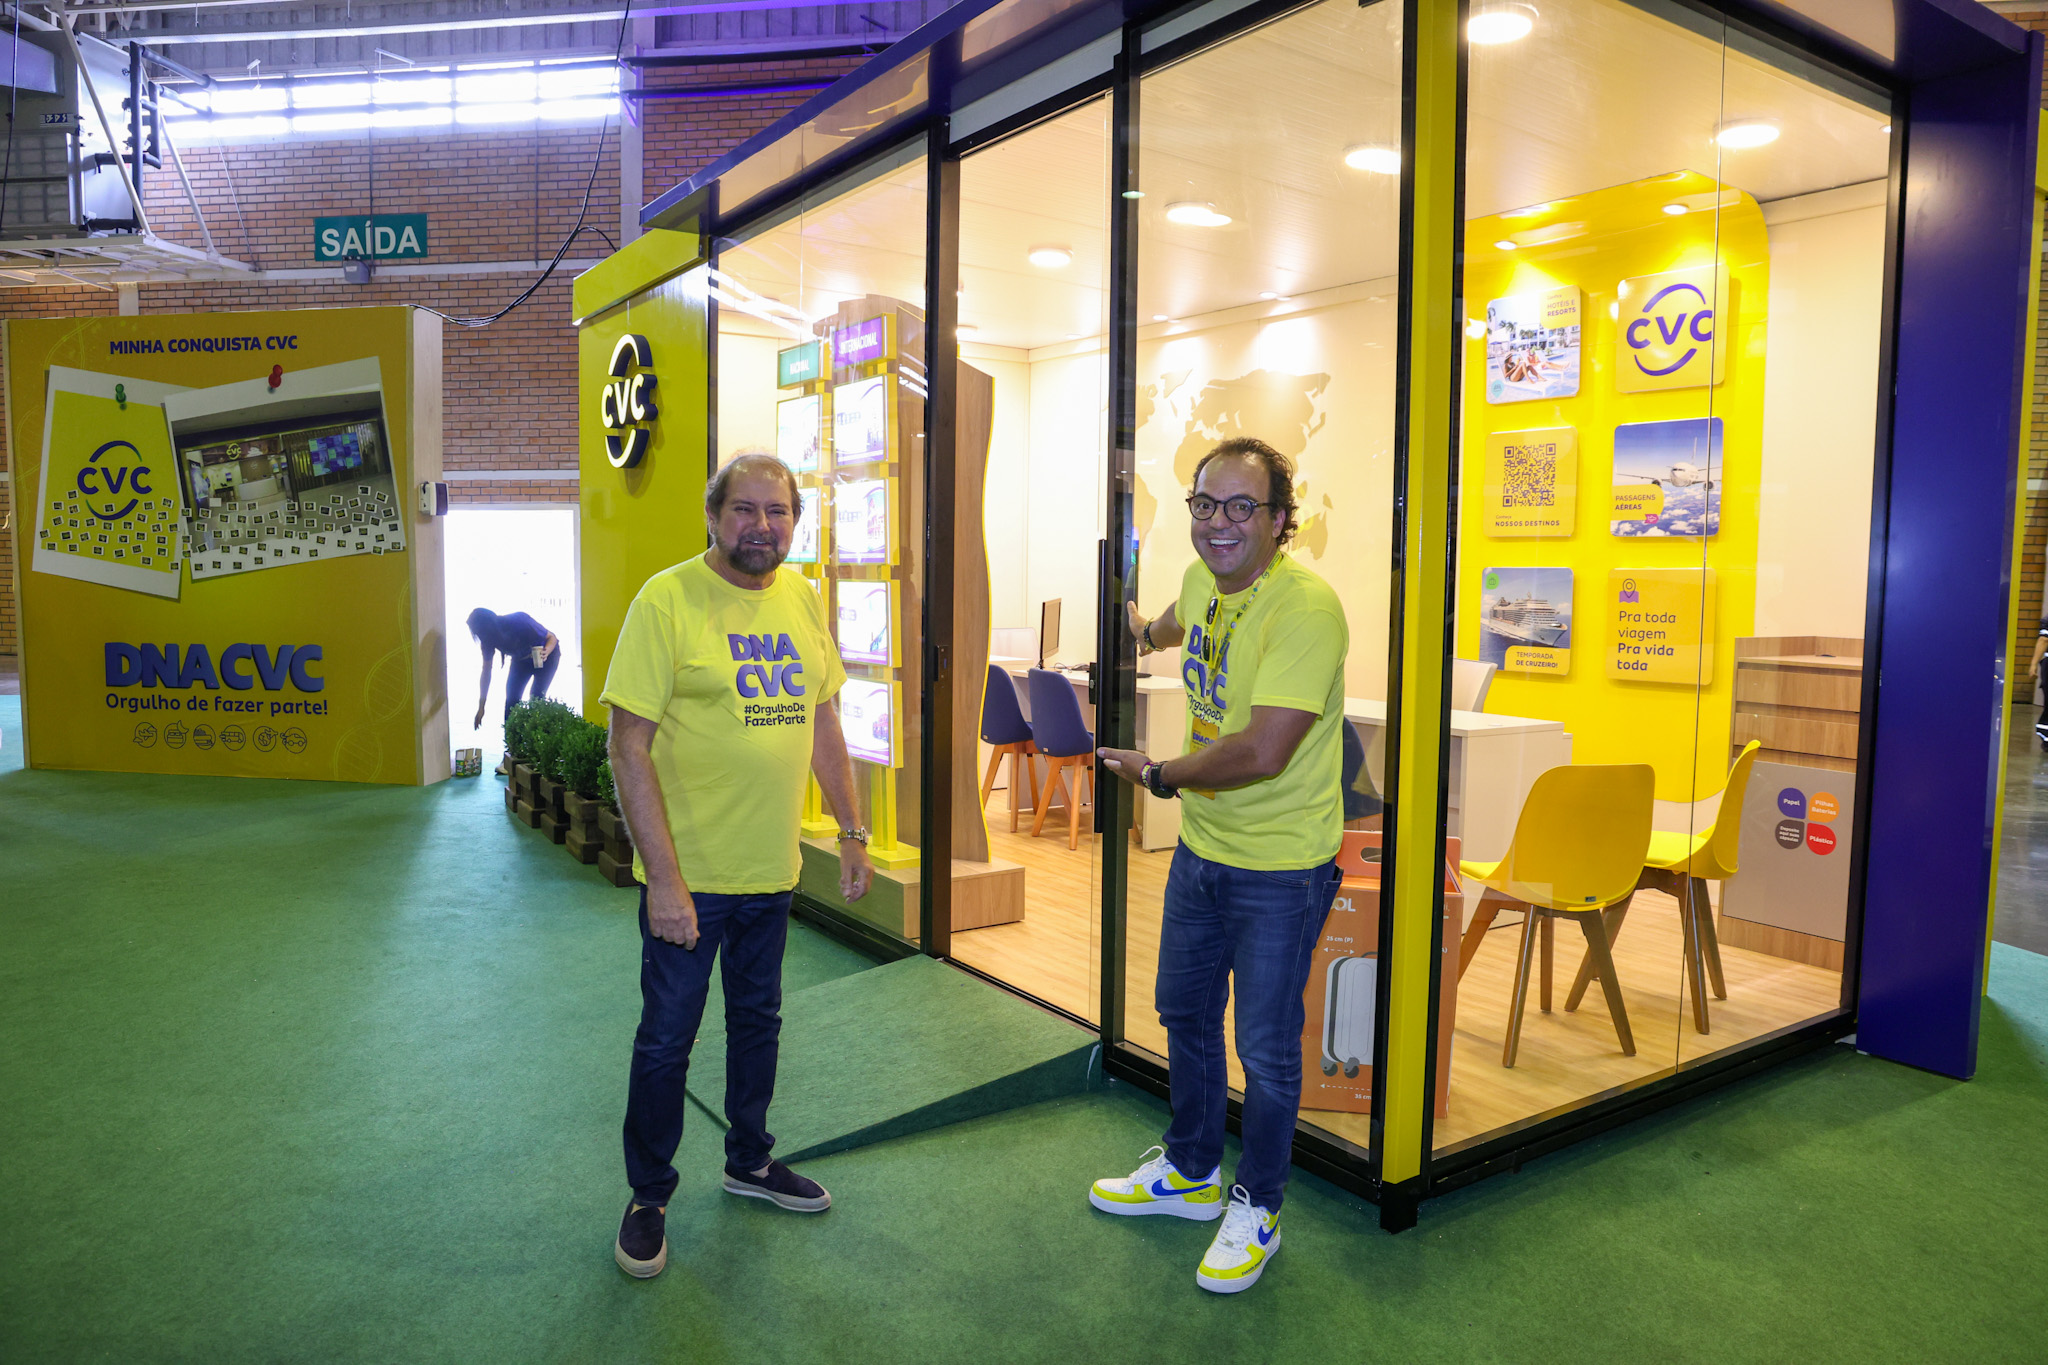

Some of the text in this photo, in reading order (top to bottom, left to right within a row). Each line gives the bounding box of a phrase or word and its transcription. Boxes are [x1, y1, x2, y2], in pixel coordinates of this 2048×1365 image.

[321, 220, 421, 257] SAÍDA
[1547, 300, 1570, 309] HOTÉIS
[1547, 306, 1577, 317] RESORTS
[1626, 309, 1713, 350] CVC
[110, 335, 298, 355] MINHA CONQUISTA CVC
[601, 373, 652, 429] CVC
[226, 447, 242, 456] CVC
[77, 466, 153, 495] CVC
[1615, 494, 1656, 502] PASSAGENS
[1615, 503, 1642, 511] AÉREAS
[1525, 519, 1560, 527] DESTINOS
[1619, 610, 1677, 624] Pra toda
[1618, 626, 1666, 642] viagem
[727, 633, 801, 662] DNA
[1618, 642, 1674, 656] Pra vida
[1516, 651, 1554, 659] TEMPORADA
[1525, 660, 1558, 669] CRUZEIRO!
[1617, 659, 1648, 671] toda
[736, 662, 806, 698] CVC
[106, 693, 328, 717] Orgulho de fazer parte!
[744, 703, 805, 716] #OrgulhoDe
[745, 715, 806, 727] FazerParte
[1783, 798, 1800, 806] Papel
[1811, 807, 1836, 815] Baterias
[1809, 836, 1833, 845] Plástico
[1344, 936, 1354, 944] (P)
